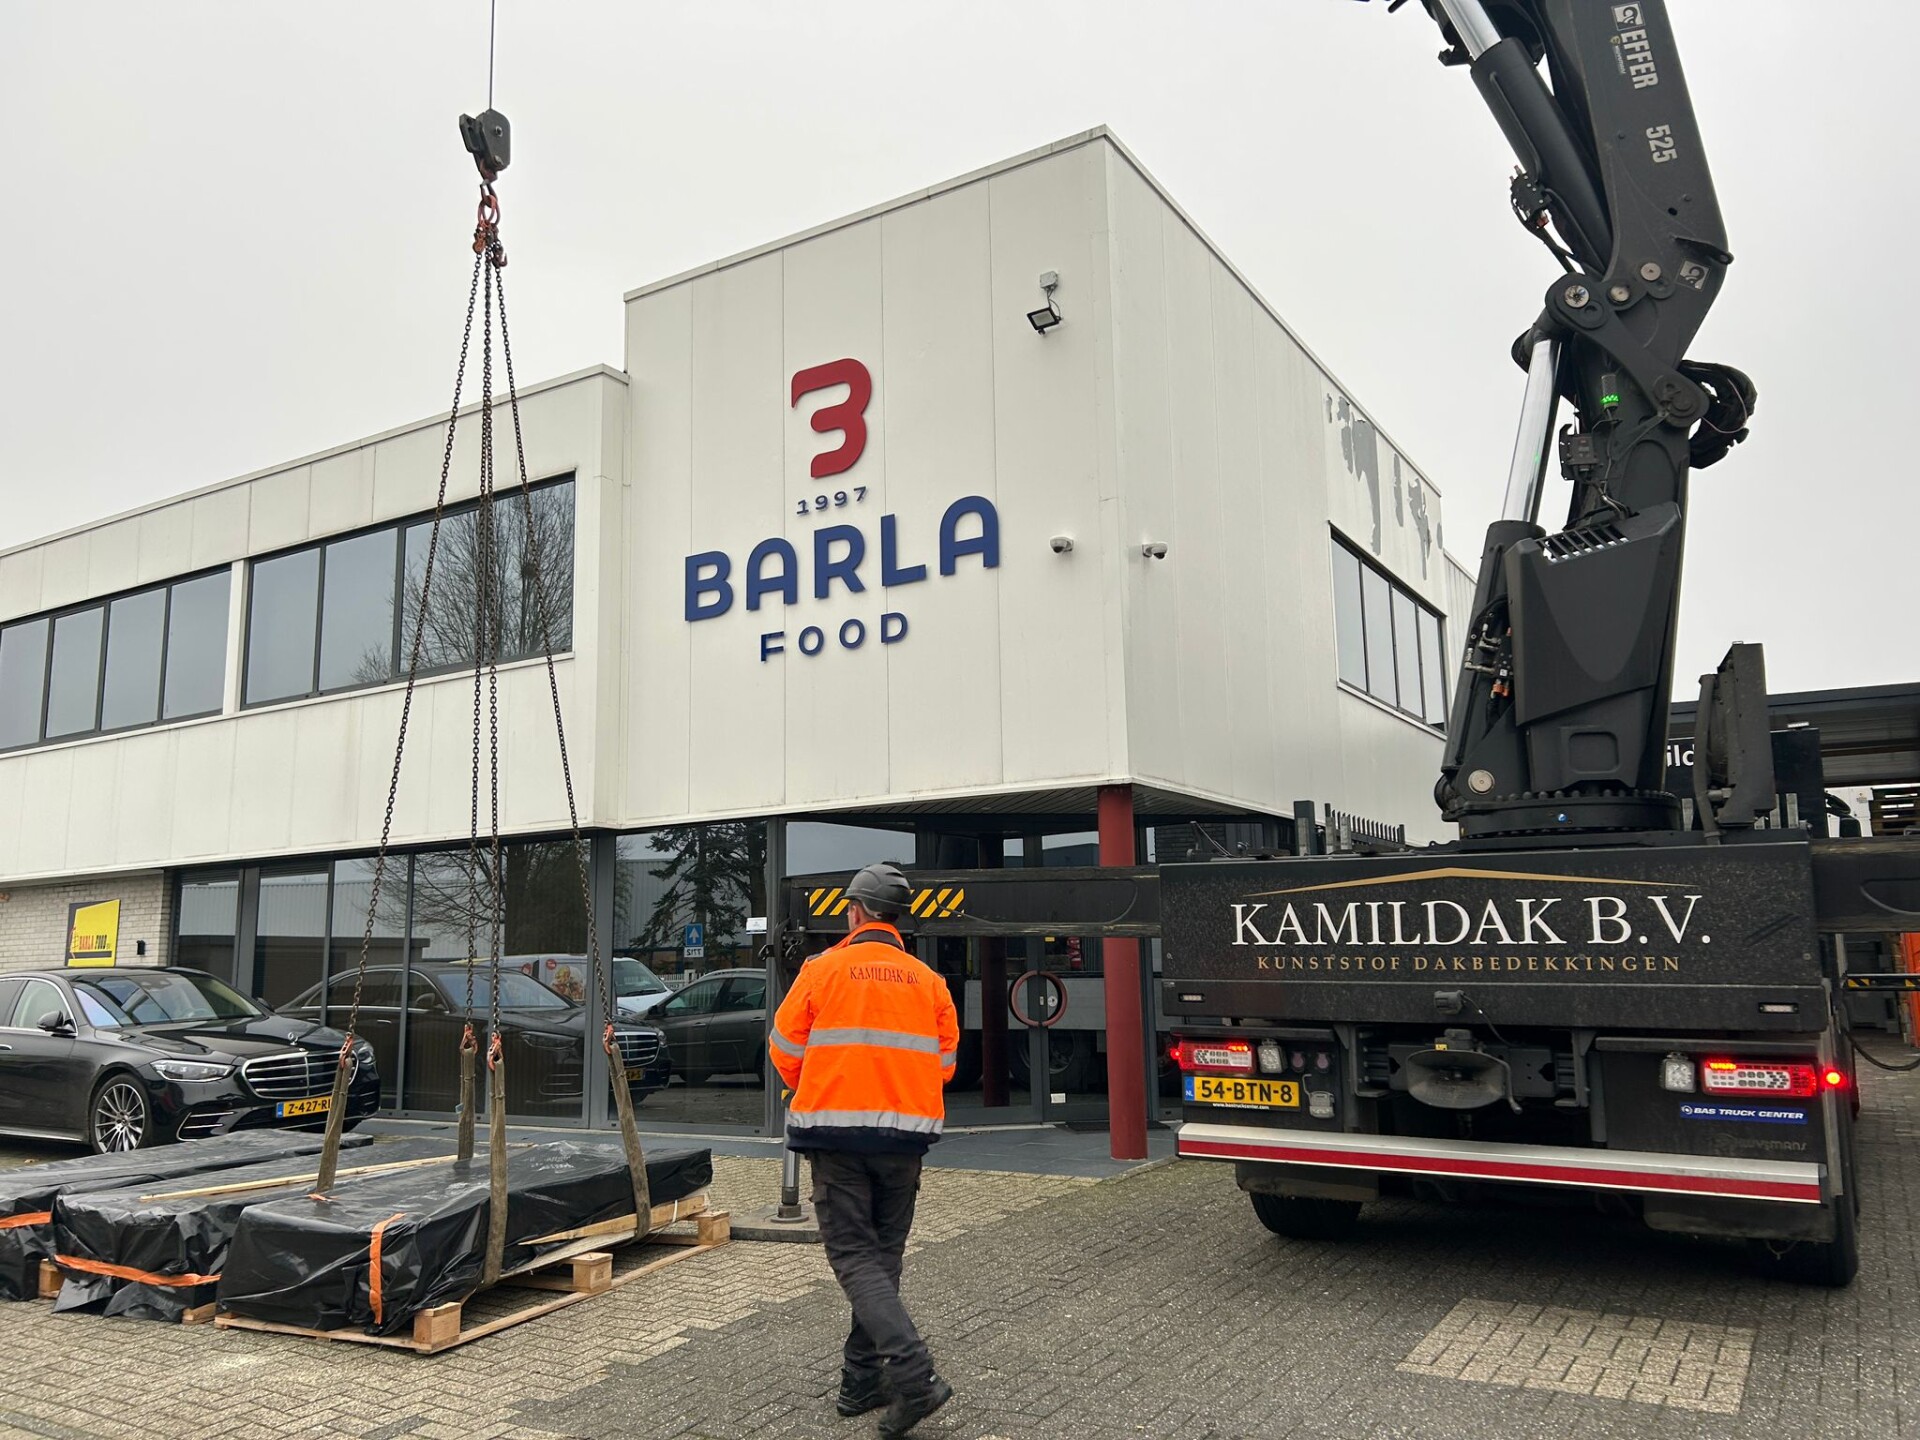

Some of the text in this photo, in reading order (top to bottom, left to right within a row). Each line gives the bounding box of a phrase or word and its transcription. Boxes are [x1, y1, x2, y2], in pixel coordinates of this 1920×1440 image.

[1620, 29, 1658, 89] EFFER
[1646, 124, 1678, 163] 525
[796, 486, 867, 515] 1997
[685, 495, 1001, 622] BARLA
[760, 612, 908, 662] FOOD
[1230, 895, 1711, 946] KAMILDAK B.V.
[849, 966, 903, 983] KAMILDAK
[1257, 956, 1680, 971] KUNSTSTOF DAKBEDEKKINGEN
[1201, 1080, 1293, 1103] 54-BTN-8
[1694, 1107, 1804, 1119] BAS TRUCK CENTER
